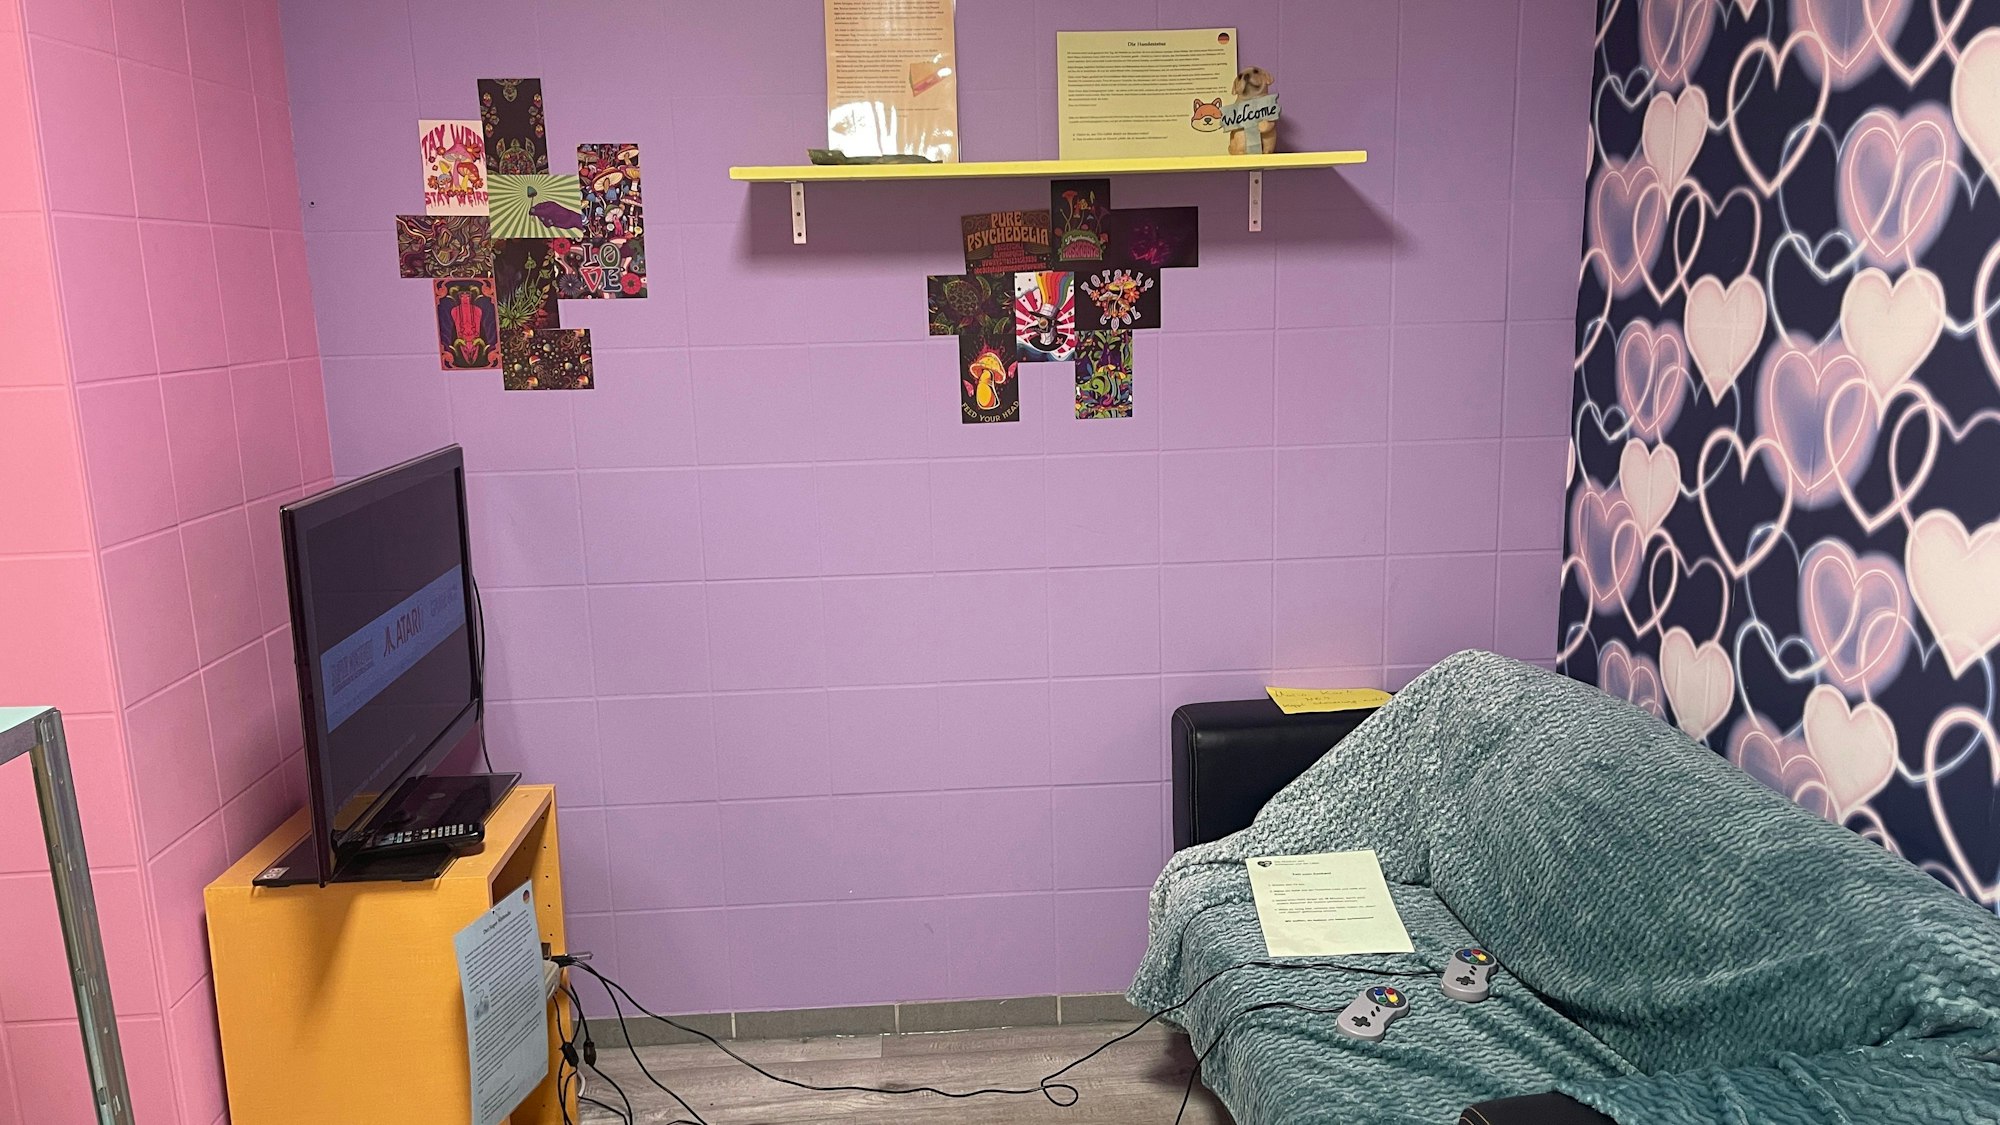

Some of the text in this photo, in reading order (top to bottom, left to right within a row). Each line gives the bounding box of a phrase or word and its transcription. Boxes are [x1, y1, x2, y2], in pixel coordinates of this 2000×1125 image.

[1221, 103, 1276, 126] Welcome
[424, 192, 451, 208] STAY
[990, 211, 1022, 229] PURE
[967, 226, 1049, 252] PSYCHEDELIA
[1100, 305, 1142, 331] COOL
[961, 400, 1019, 422] FEED YOUR HEAD
[396, 605, 423, 649] ATARI
